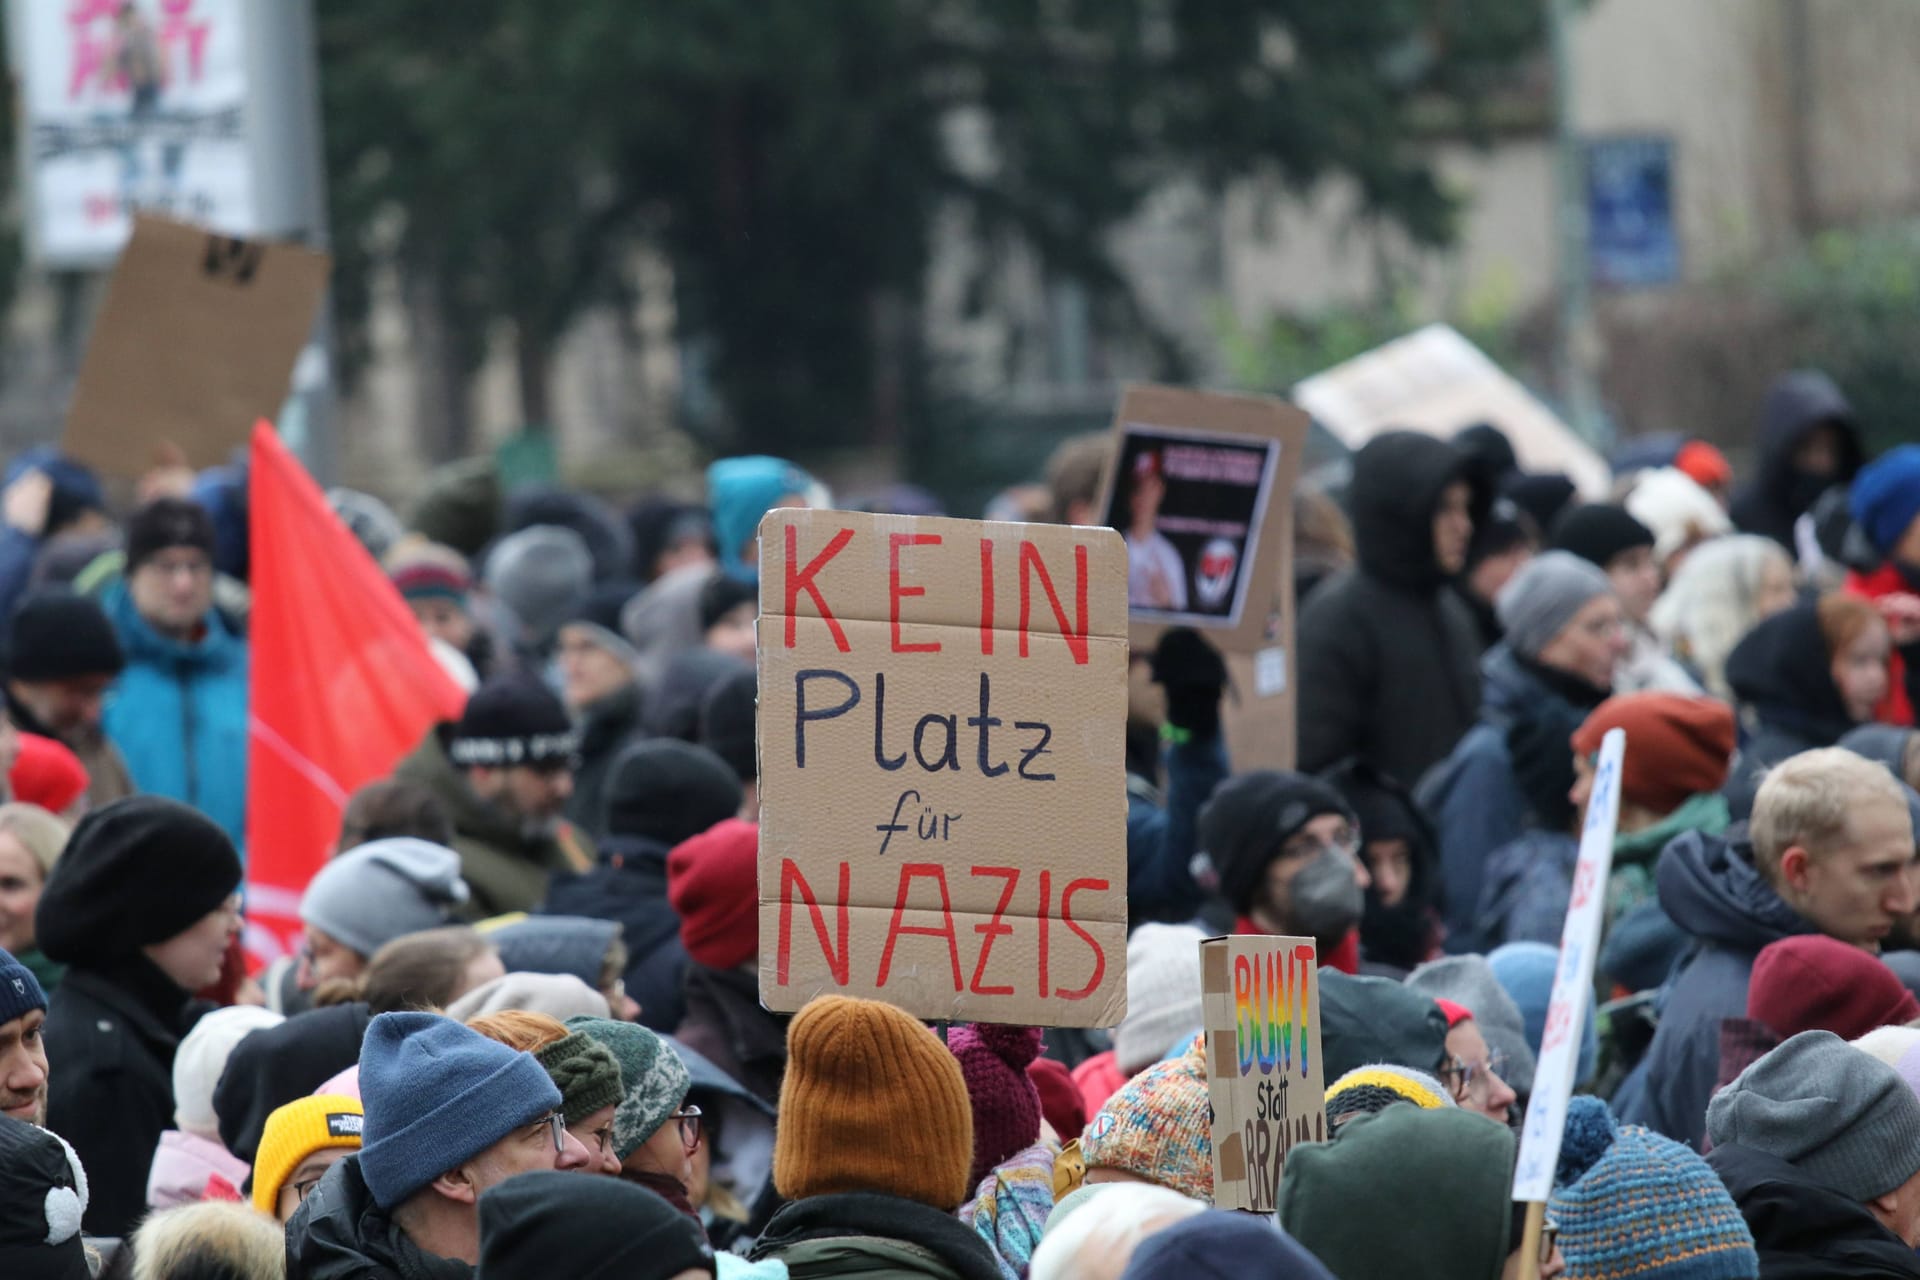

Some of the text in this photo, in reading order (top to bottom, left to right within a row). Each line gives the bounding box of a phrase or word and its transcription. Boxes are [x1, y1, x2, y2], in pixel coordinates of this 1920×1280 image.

[784, 524, 1089, 665] KEIN
[795, 669, 1057, 781] Platz
[876, 790, 962, 855] für
[777, 858, 1110, 1000] NAZIS
[1234, 945, 1315, 1079] BUNT
[1245, 1111, 1323, 1211] BRA
